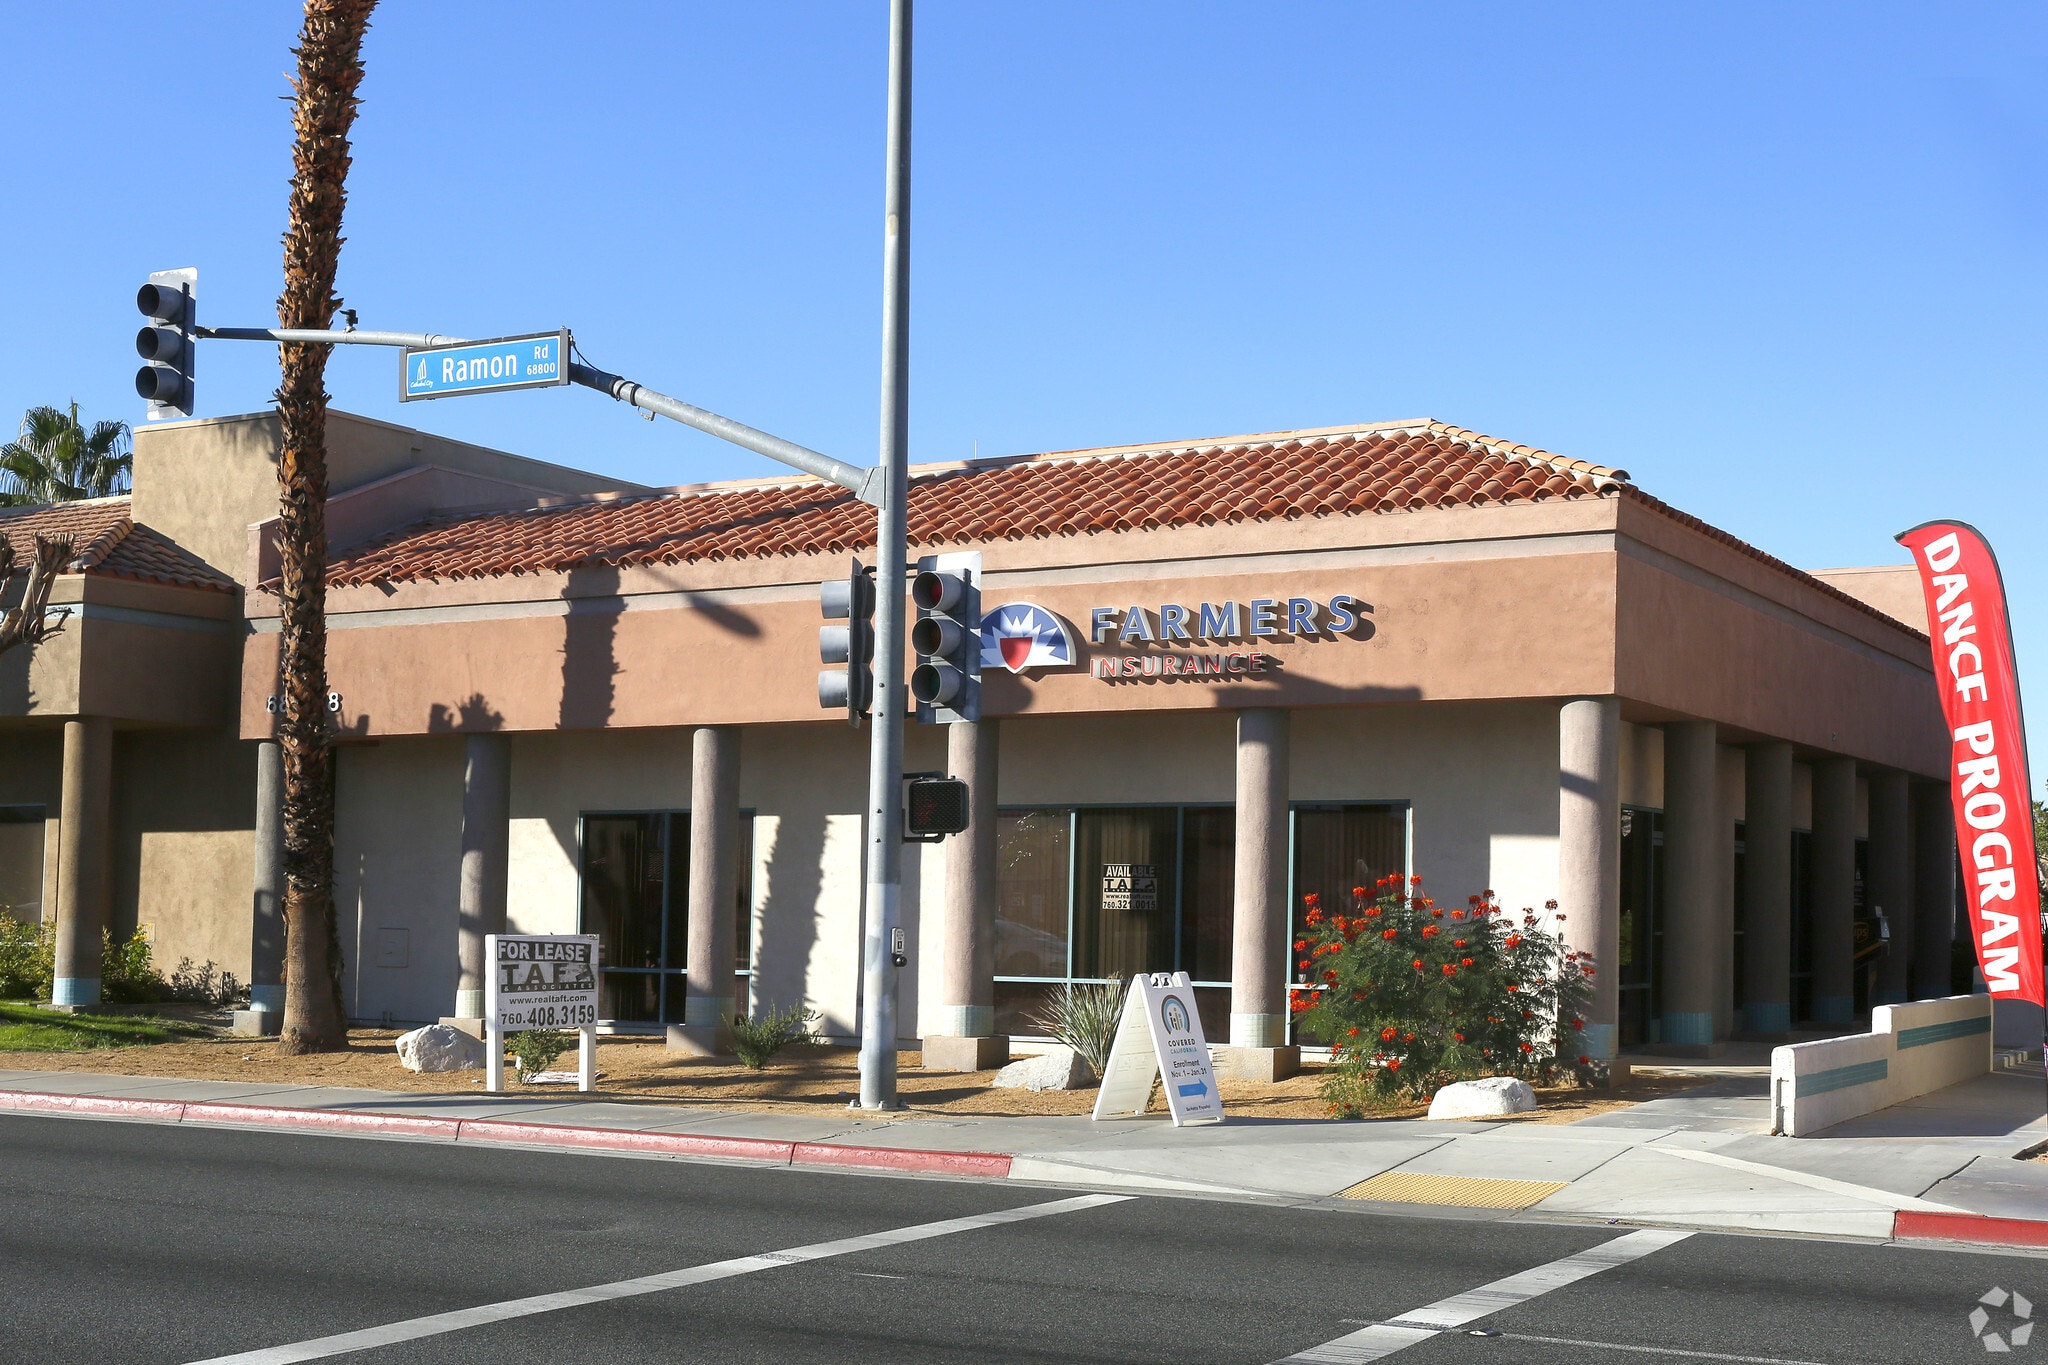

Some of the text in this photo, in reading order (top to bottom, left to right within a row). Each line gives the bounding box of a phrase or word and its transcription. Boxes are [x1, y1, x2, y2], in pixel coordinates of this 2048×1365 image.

[442, 344, 548, 383] Ramon Rd
[527, 362, 555, 375] 68800
[1090, 594, 1358, 644] FARMERS
[1924, 531, 1988, 704] DANCE
[1089, 651, 1266, 679] INSURANCE
[1953, 718, 2019, 993] PROGRAM
[1106, 865, 1155, 877] AVAILABLE
[498, 941, 584, 961] FOR LEASE
[517, 983, 593, 991] ASSOCIATES
[509, 994, 587, 1005] www.realtaft.com
[501, 1004, 595, 1027] 760.408.3159
[1168, 1038, 1196, 1047] COVERED
[1173, 1059, 1200, 1068] Enrollment
